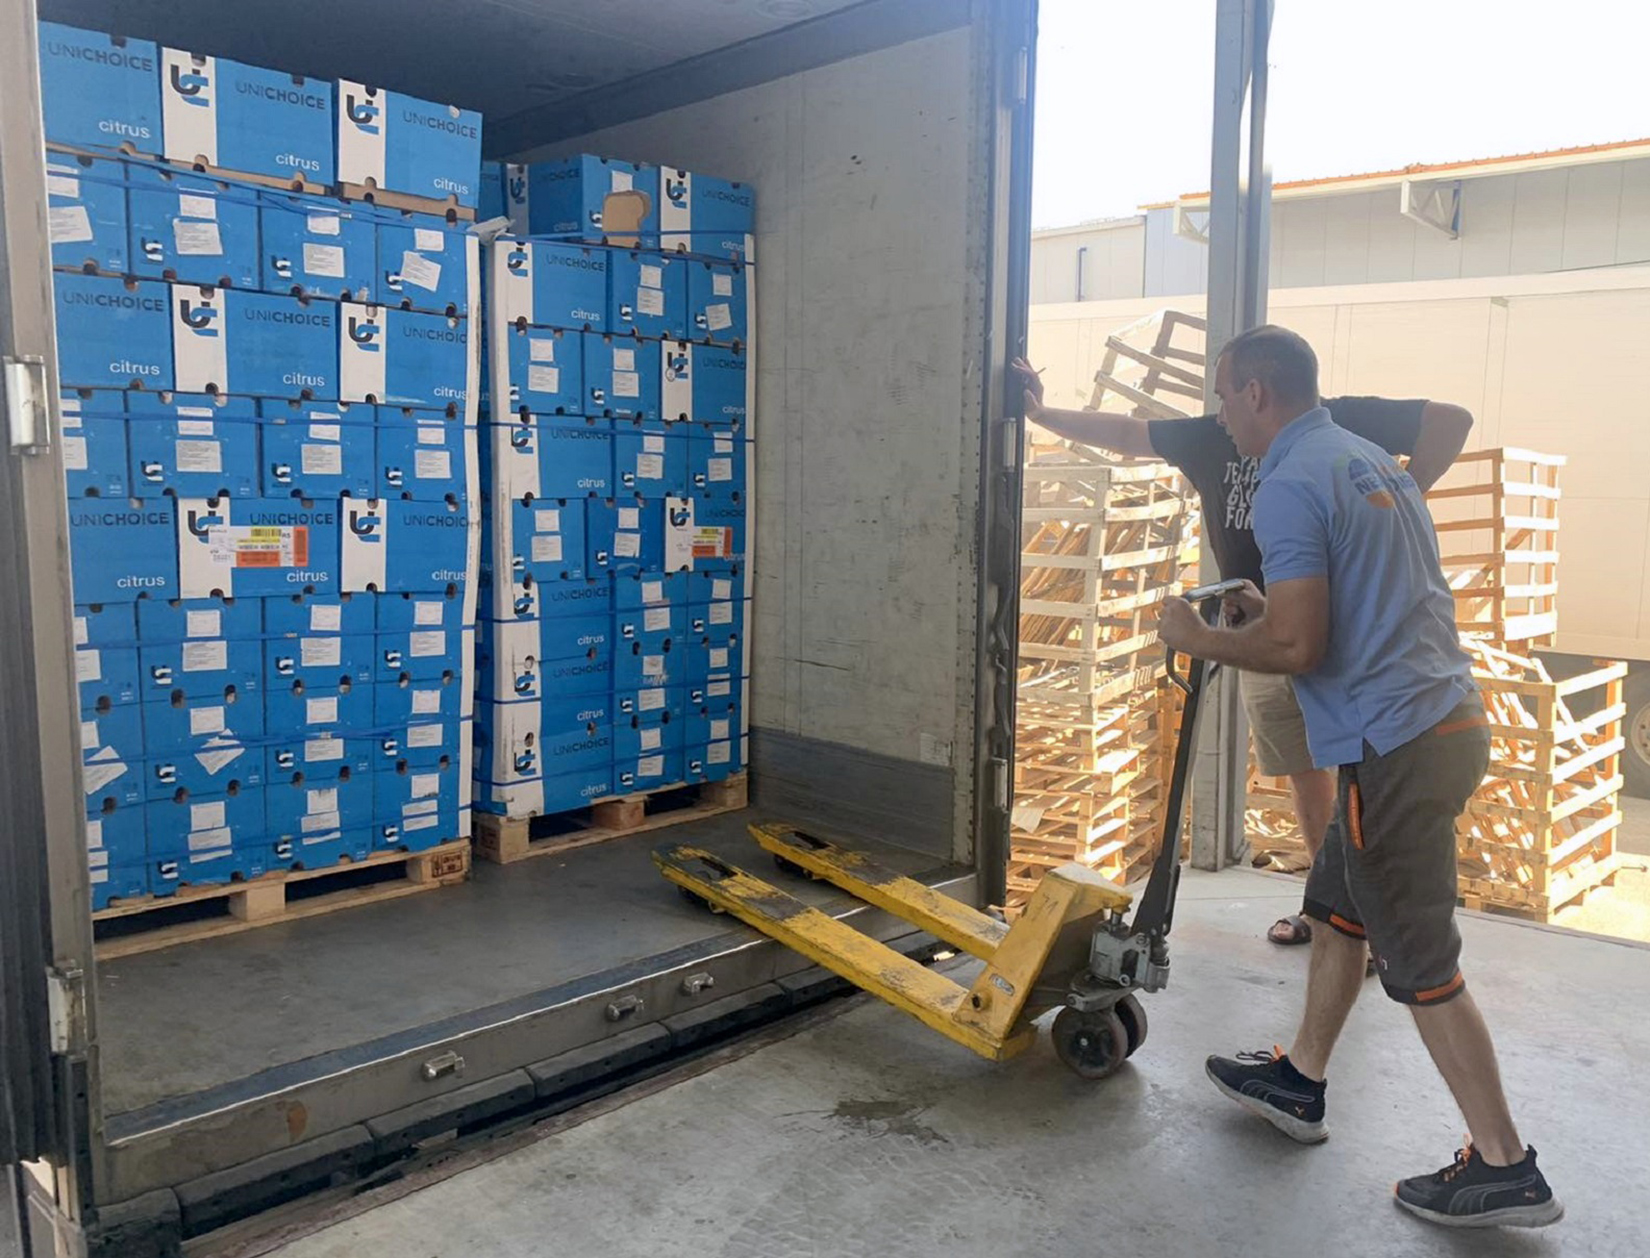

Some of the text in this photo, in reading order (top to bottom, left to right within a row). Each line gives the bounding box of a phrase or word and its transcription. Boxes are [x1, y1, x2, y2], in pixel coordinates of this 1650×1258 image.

[47, 41, 153, 72] UNICHOICE
[235, 81, 326, 110] UNICHOICE
[98, 118, 151, 139] citrus
[402, 110, 478, 139] UNICHOICE
[275, 153, 320, 172] citrus
[433, 177, 469, 195] citrus
[546, 254, 605, 272] UNICHOICE
[62, 291, 164, 312] UNICHOICE
[244, 308, 331, 327] UNICHOICE
[571, 308, 600, 321] citrus
[402, 325, 467, 344] UNICHOIC
[109, 360, 160, 376] citrus
[282, 371, 325, 387] citrus
[577, 478, 605, 489] citrus
[71, 512, 169, 527] UNICHOICE
[250, 512, 334, 526] UNICHOICE
[403, 514, 467, 528] UNICHOIC
[117, 574, 165, 589] citrus
[286, 569, 328, 584] citrus
[551, 587, 609, 602] UNICHOICE
[577, 635, 605, 646] citrus
[553, 661, 609, 679] UNICHOICE
[577, 708, 604, 721] citrus
[553, 737, 610, 756] UNICHOICE
[580, 782, 607, 797] citrus
